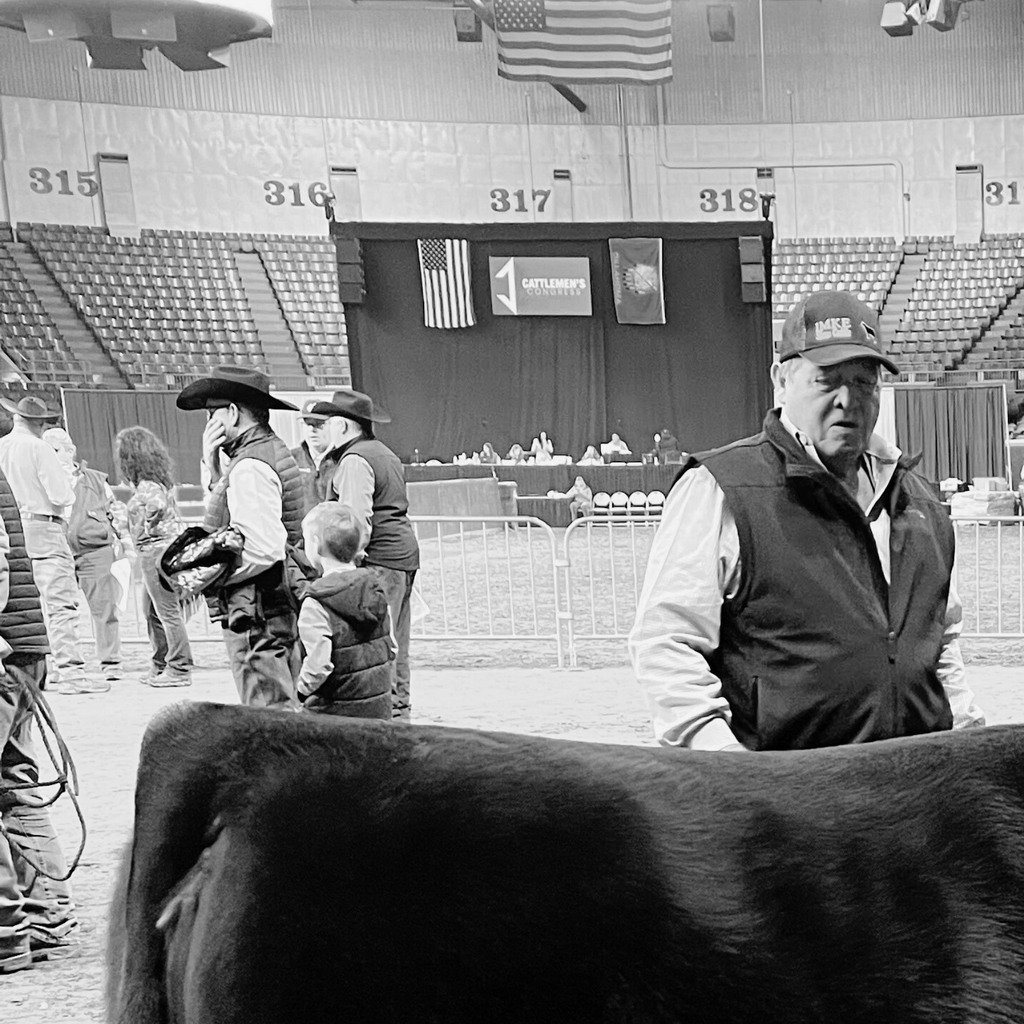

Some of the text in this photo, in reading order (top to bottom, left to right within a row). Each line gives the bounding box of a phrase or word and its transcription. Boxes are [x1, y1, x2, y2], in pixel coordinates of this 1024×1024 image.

[29, 166, 99, 197] 315
[263, 180, 329, 207] 316
[490, 188, 551, 213] 317
[700, 188, 758, 213] 318
[522, 278, 587, 289] CATTLEMEN'S
[527, 288, 582, 296] CONGRESS
